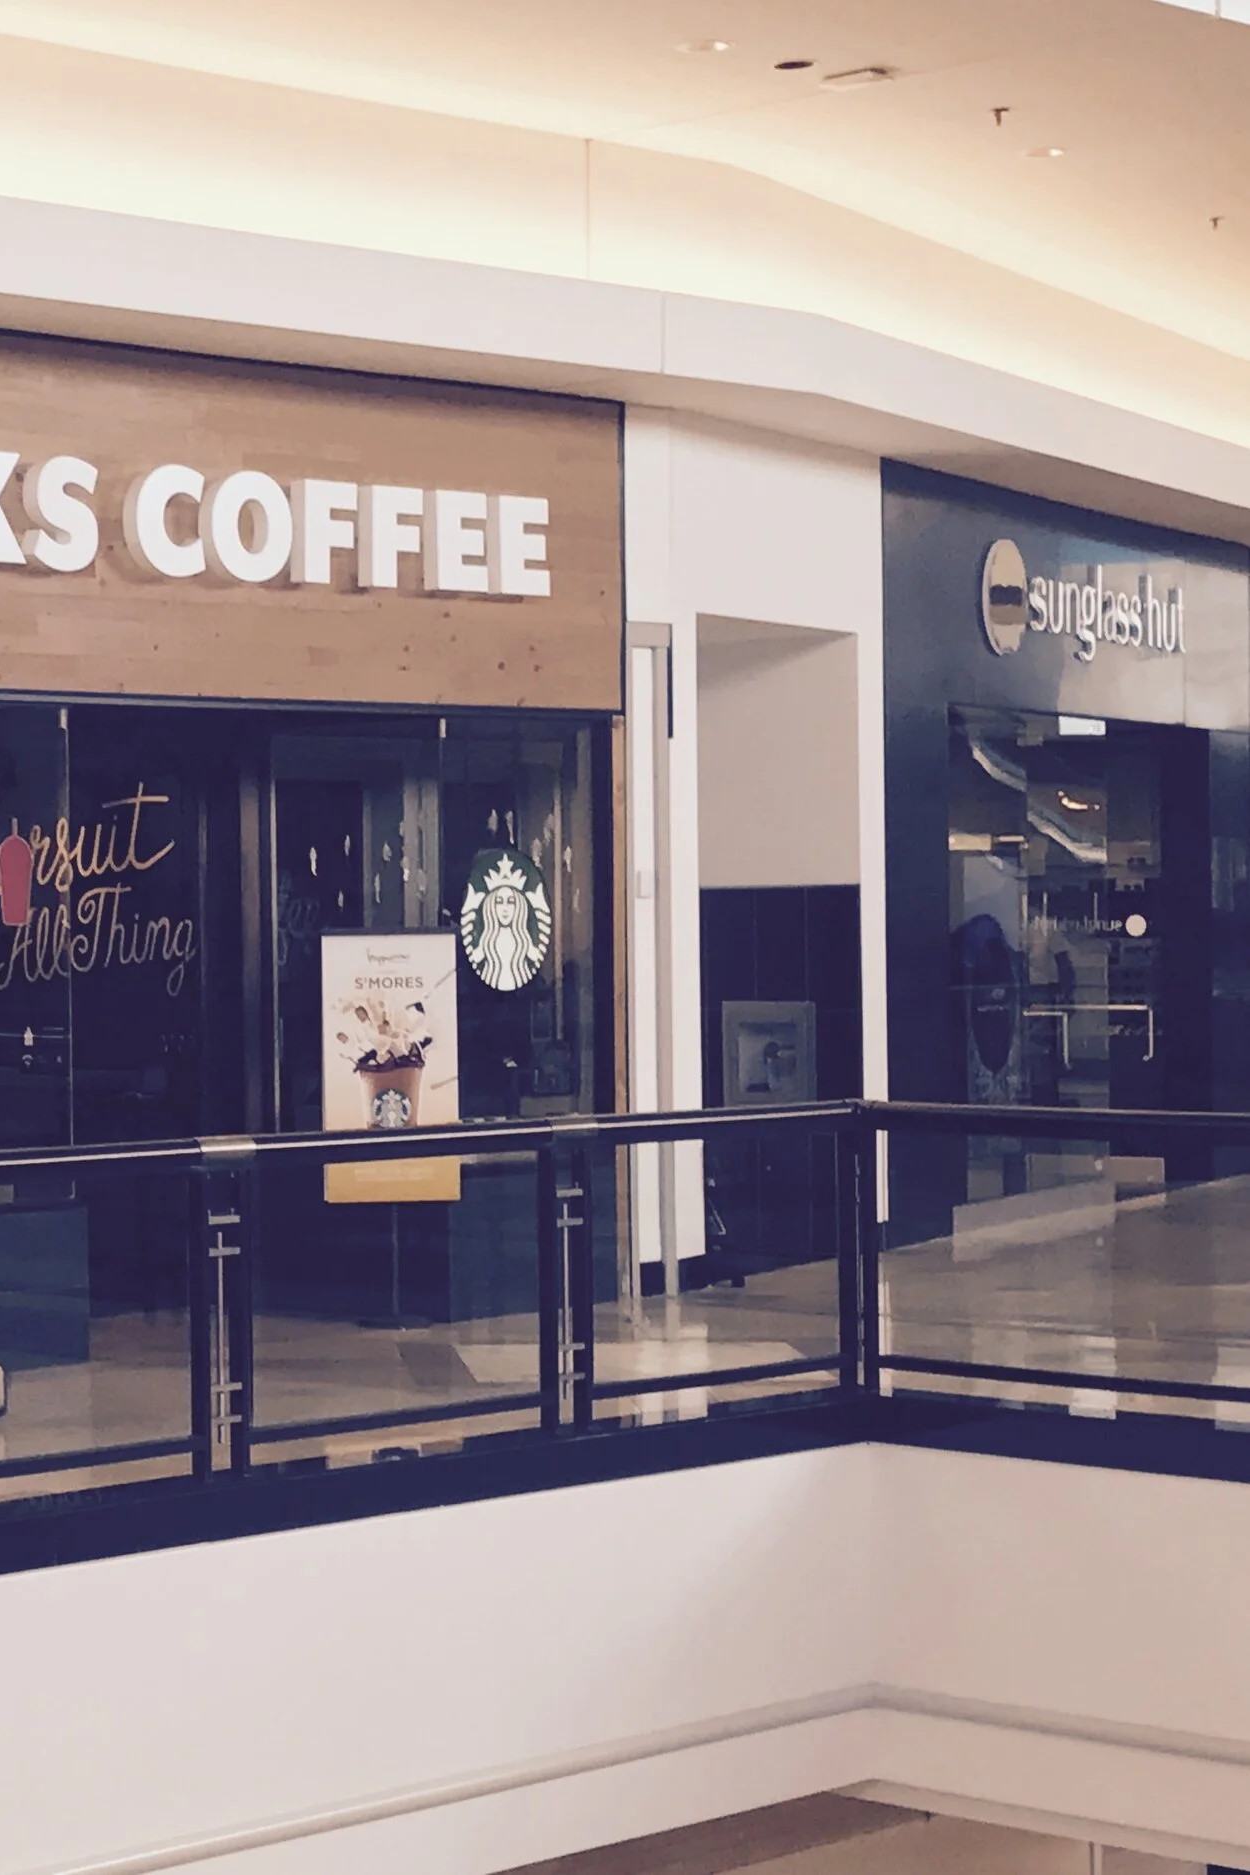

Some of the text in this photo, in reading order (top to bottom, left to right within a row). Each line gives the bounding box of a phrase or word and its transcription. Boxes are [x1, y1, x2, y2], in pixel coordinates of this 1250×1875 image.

[128, 464, 550, 597] COFFEE
[1028, 564, 1187, 662] sunglass hut
[354, 976, 424, 990] S'MORES
